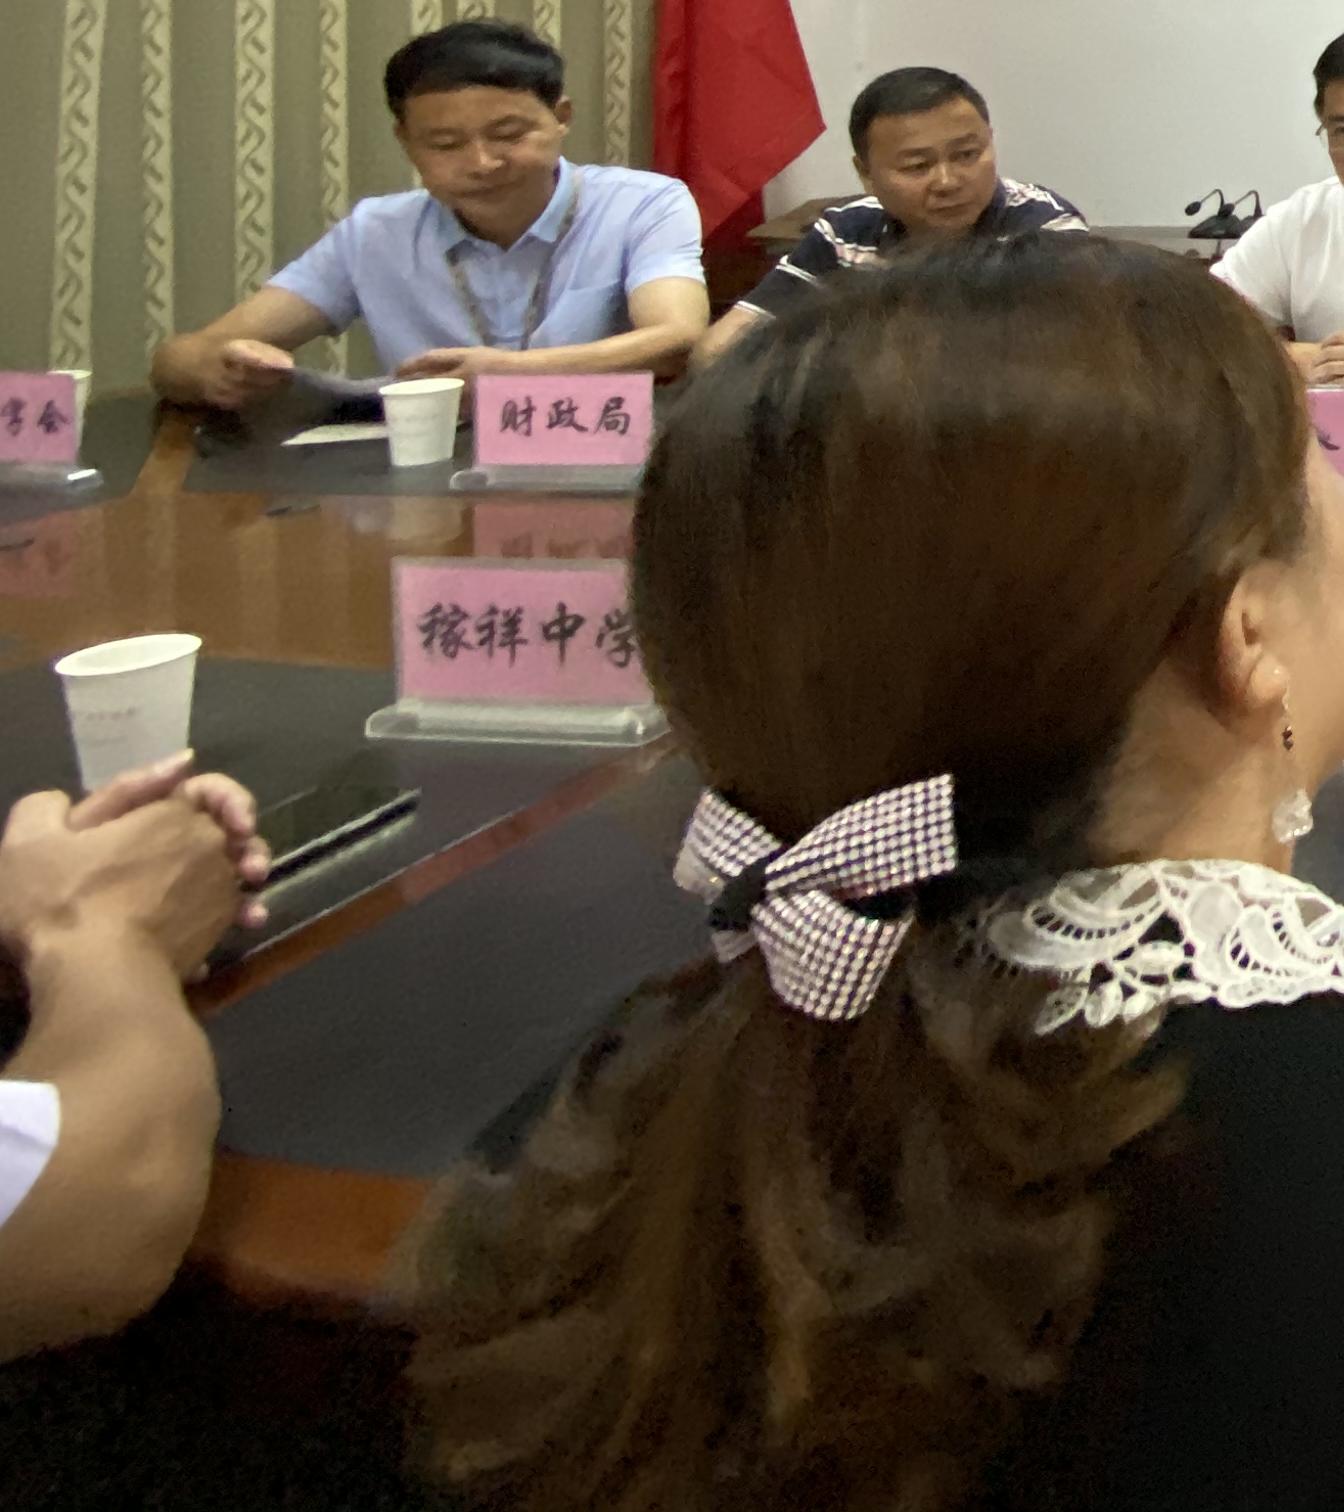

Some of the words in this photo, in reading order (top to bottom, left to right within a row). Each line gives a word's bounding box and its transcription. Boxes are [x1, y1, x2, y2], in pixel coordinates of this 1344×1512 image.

[500, 395, 632, 438] 财政局
[417, 601, 637, 668] 稼祥中学
